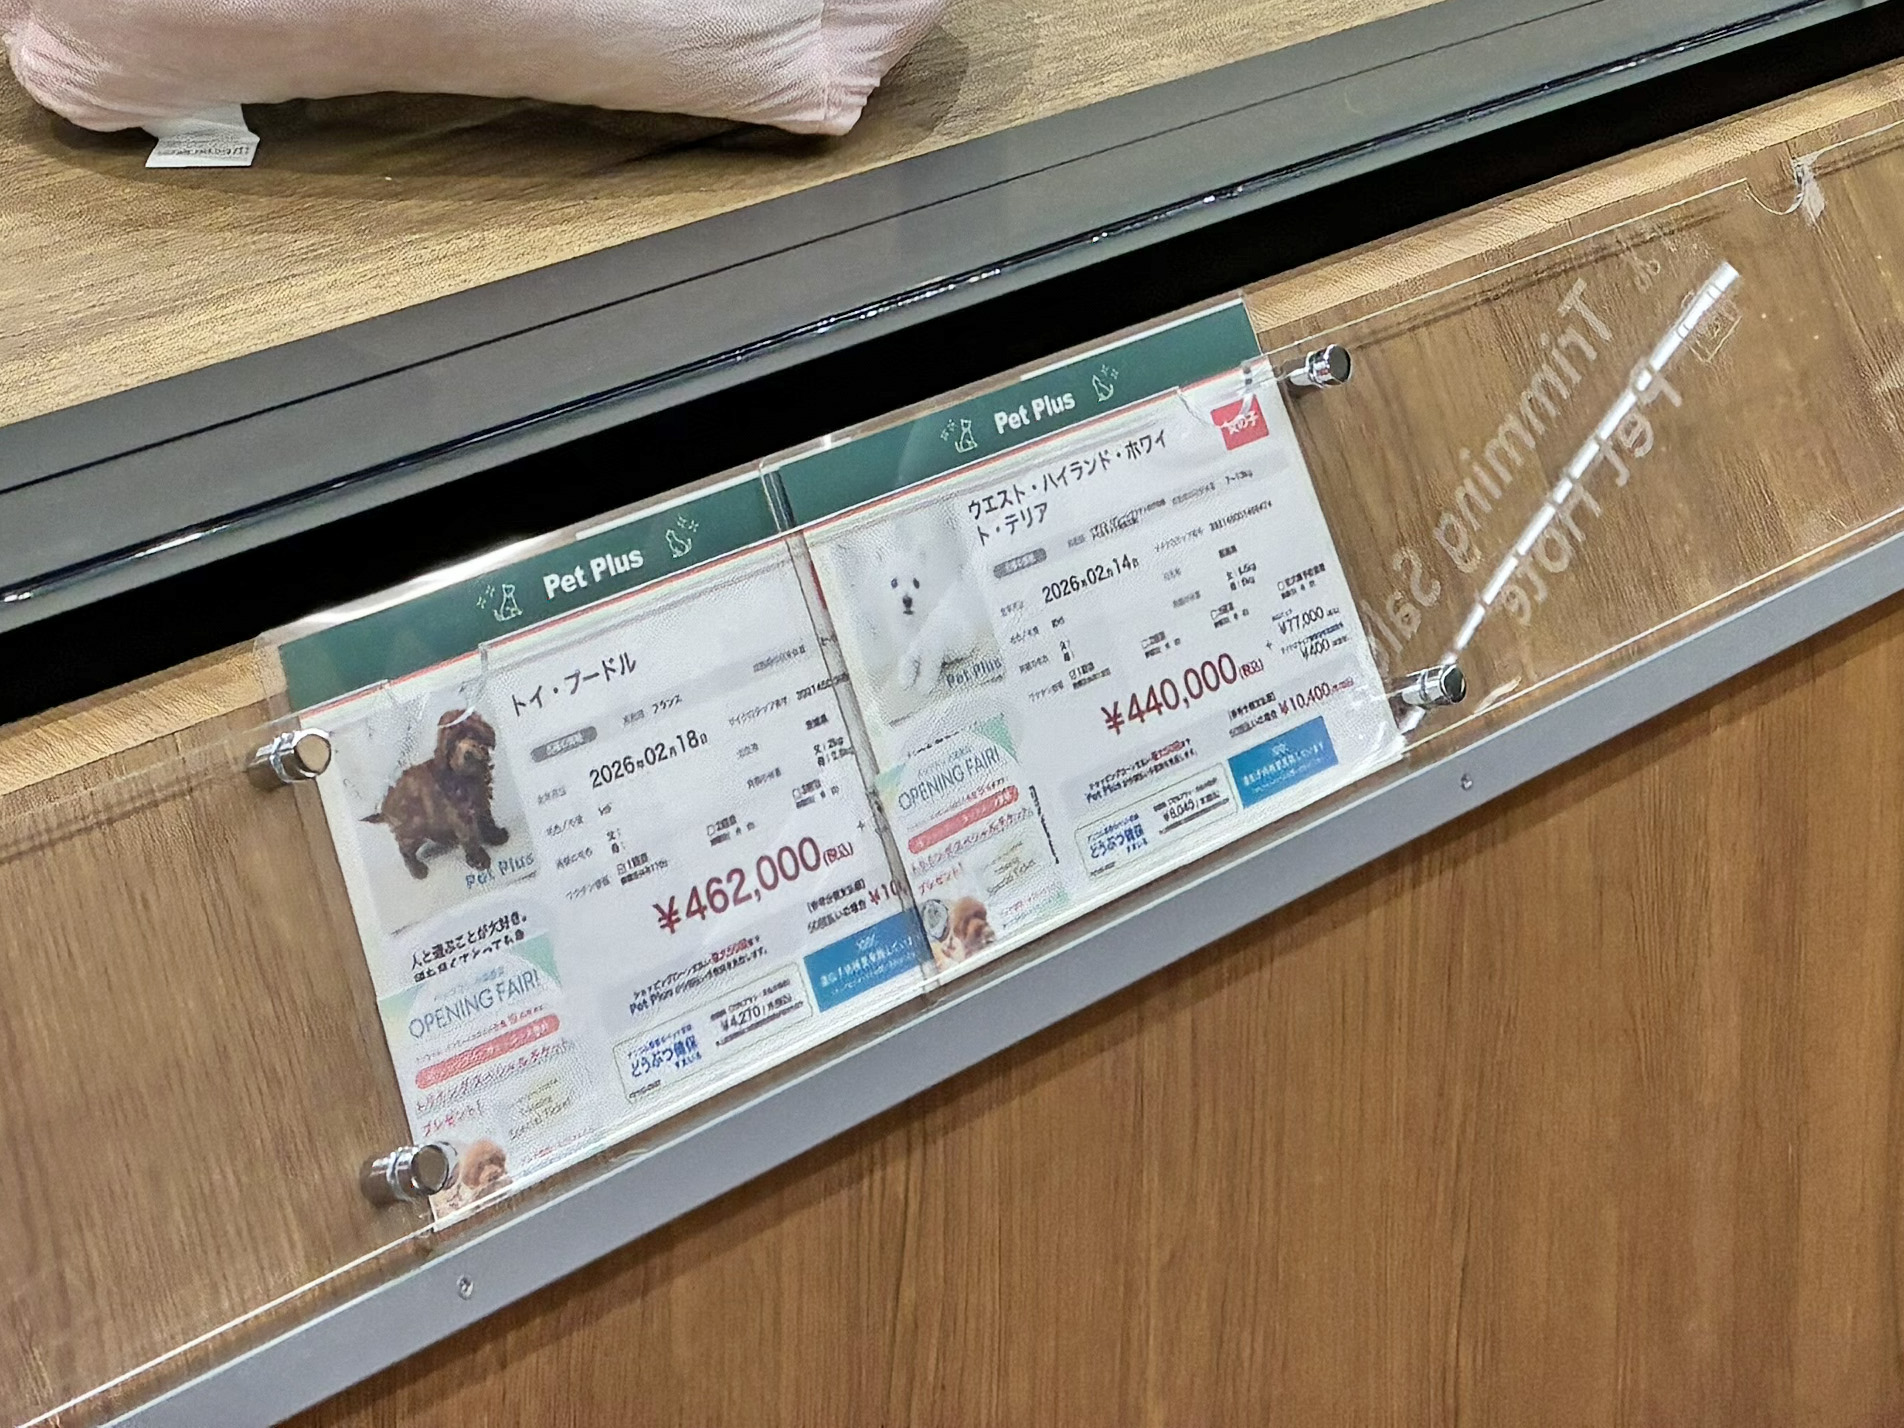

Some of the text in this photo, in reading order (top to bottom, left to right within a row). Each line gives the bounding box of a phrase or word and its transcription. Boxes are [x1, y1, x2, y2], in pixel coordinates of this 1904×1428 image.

[994, 391, 1076, 435] Pet Plus
[967, 428, 1168, 521] ウエスト・ハイランド・ホワイ
[976, 501, 1049, 547] ト・テリア
[543, 547, 645, 601] Pet Plus
[510, 650, 638, 717] トイ・プードル
[589, 728, 709, 789] 2026年02月18日
[407, 987, 495, 1040] OPENING
[631, 1034, 698, 1078] どうぶつ健保
